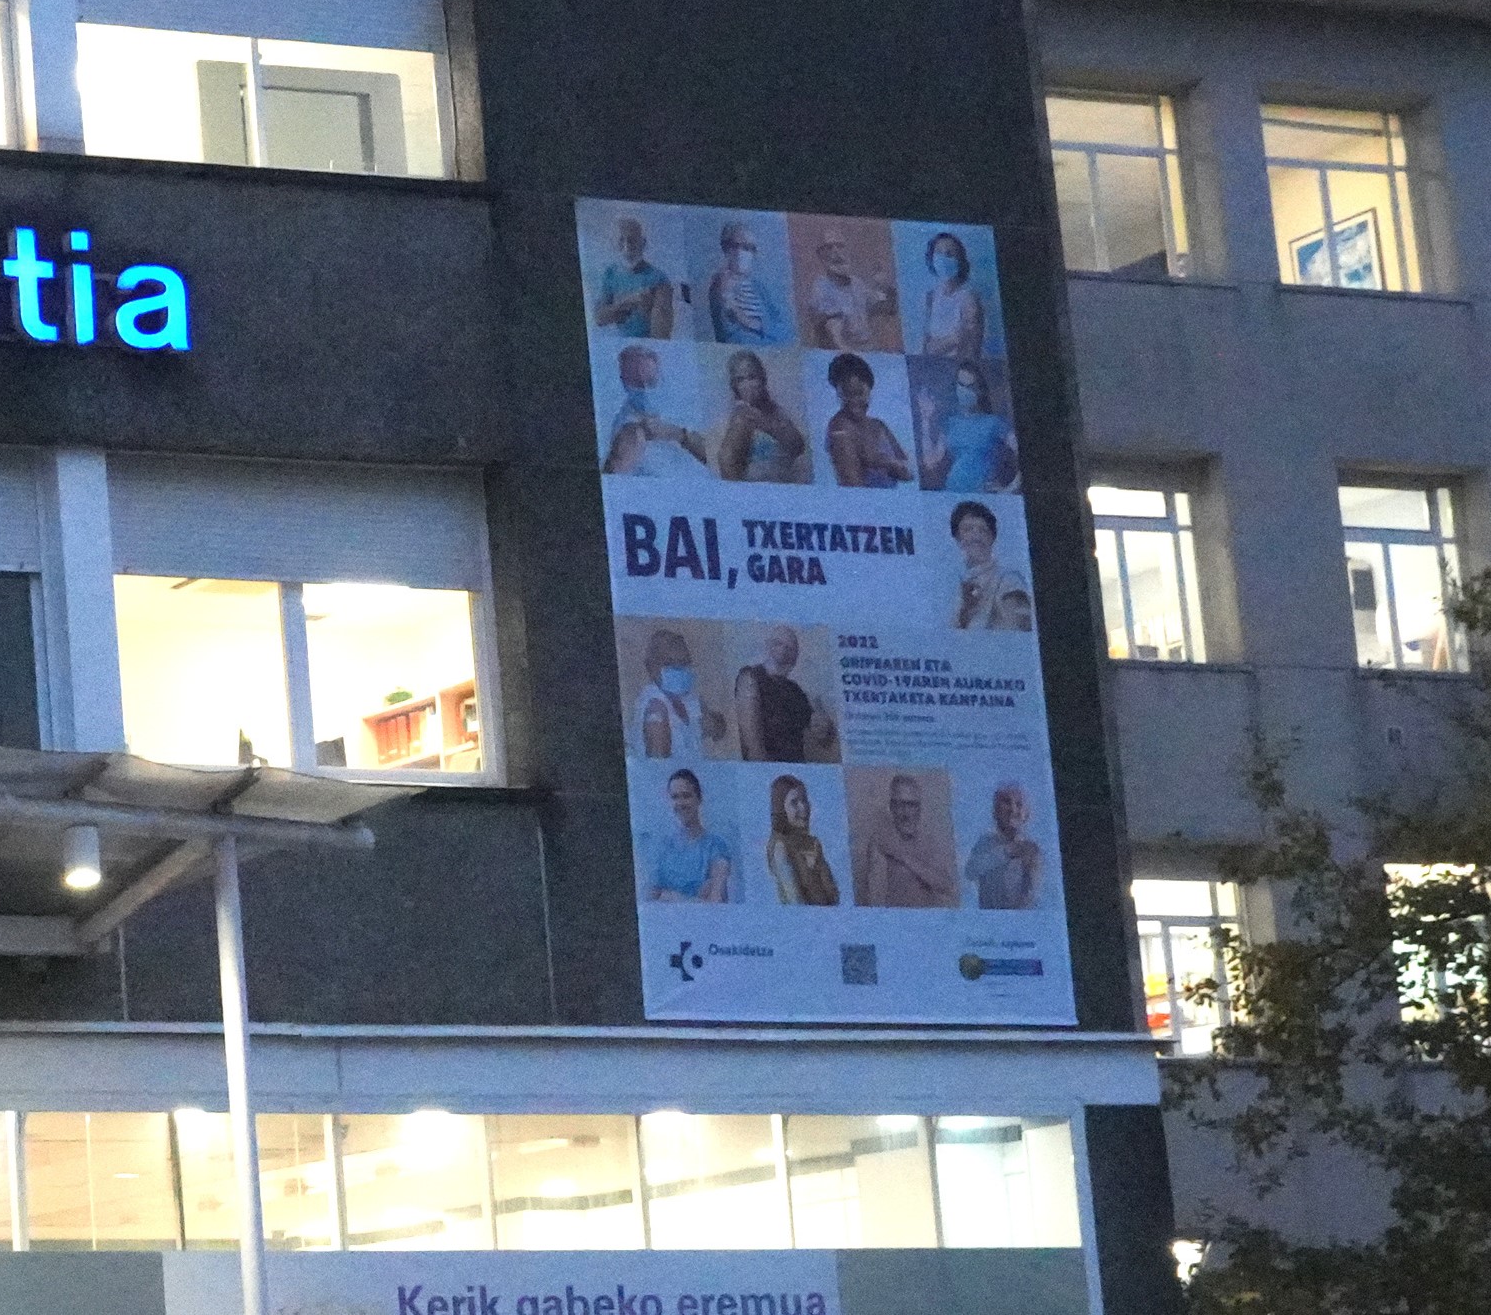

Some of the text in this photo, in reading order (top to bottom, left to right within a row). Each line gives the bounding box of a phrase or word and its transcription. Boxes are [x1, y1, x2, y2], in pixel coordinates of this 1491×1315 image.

[623, 513, 915, 589] BAI, TXERTATZEN
[746, 553, 827, 585] GARA
[838, 635, 879, 649] 2022
[924, 659, 953, 673] ETA
